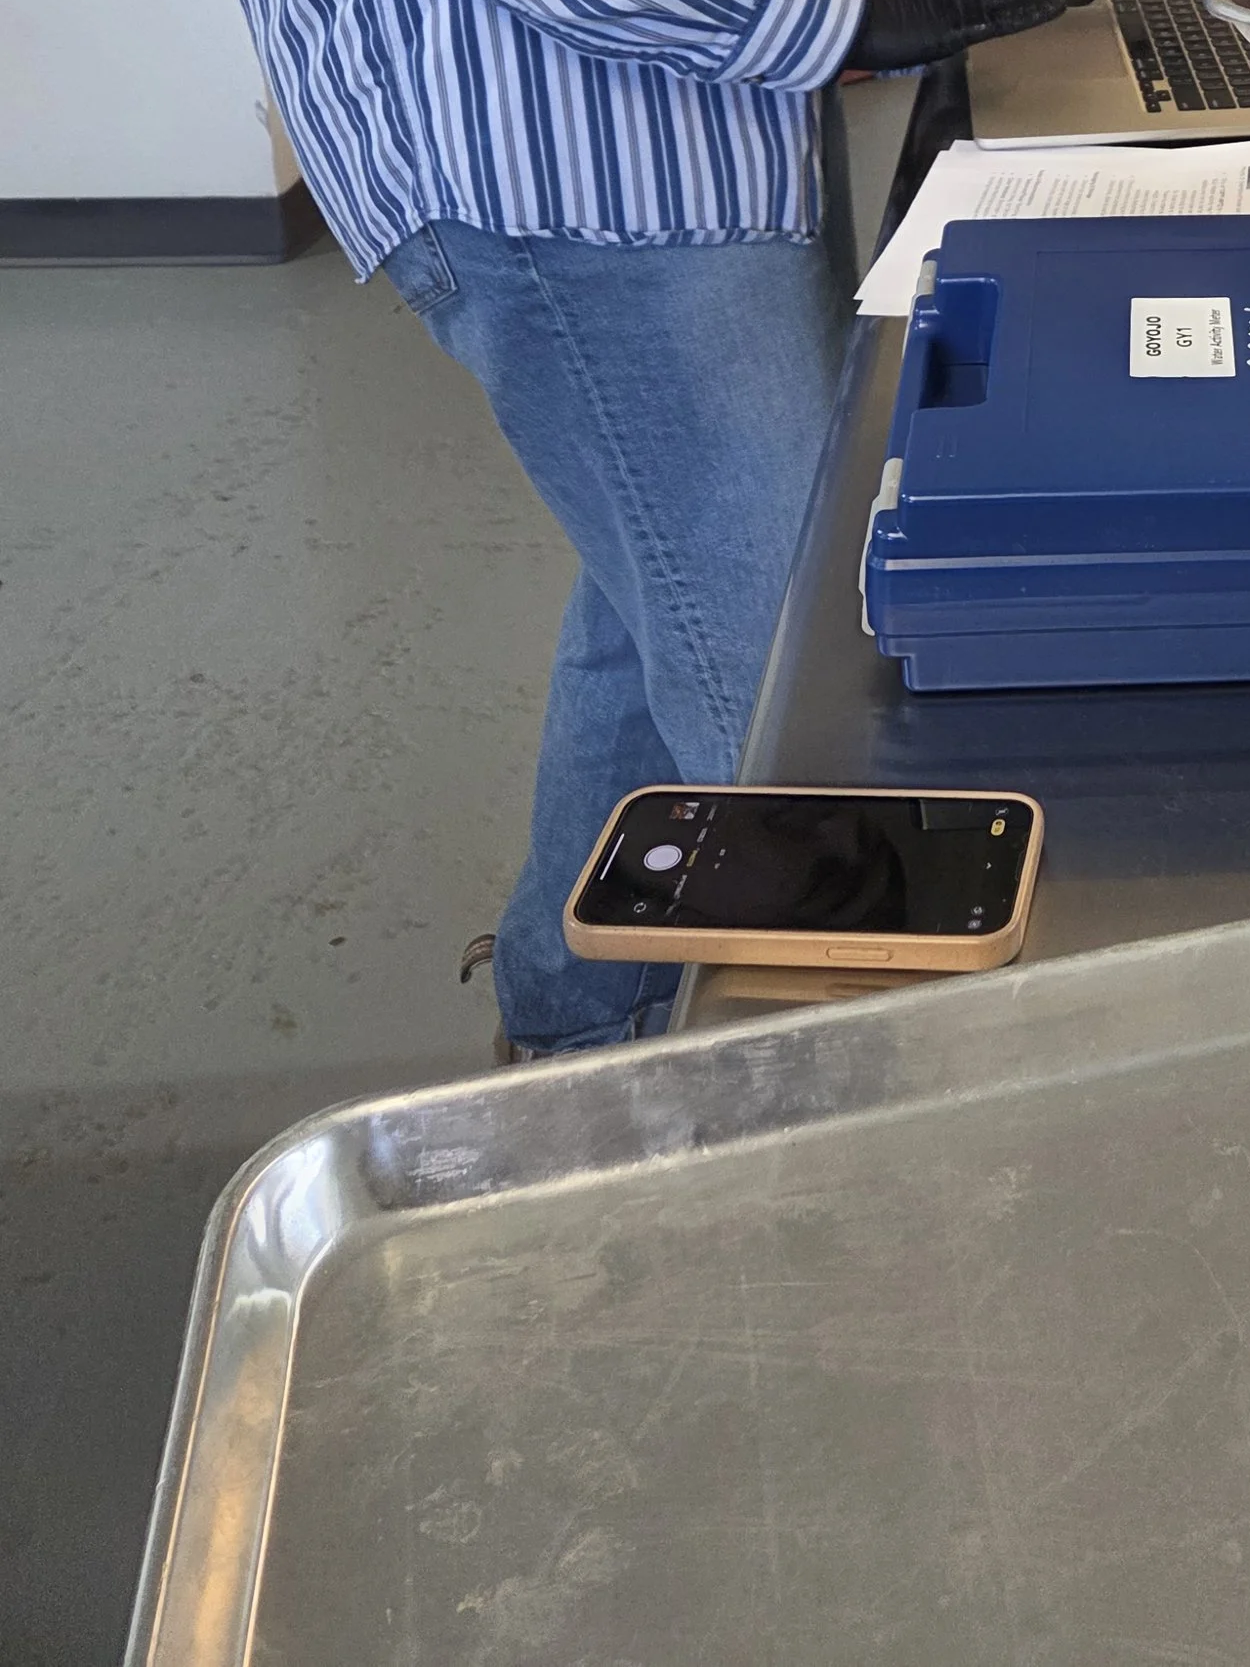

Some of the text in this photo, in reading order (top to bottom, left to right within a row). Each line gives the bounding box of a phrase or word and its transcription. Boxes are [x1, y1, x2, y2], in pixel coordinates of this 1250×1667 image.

[1146, 316, 1161, 357] GOYOJO
[1176, 327, 1193, 348] GY1
[1208, 309, 1225, 366] Water Activity Meter
